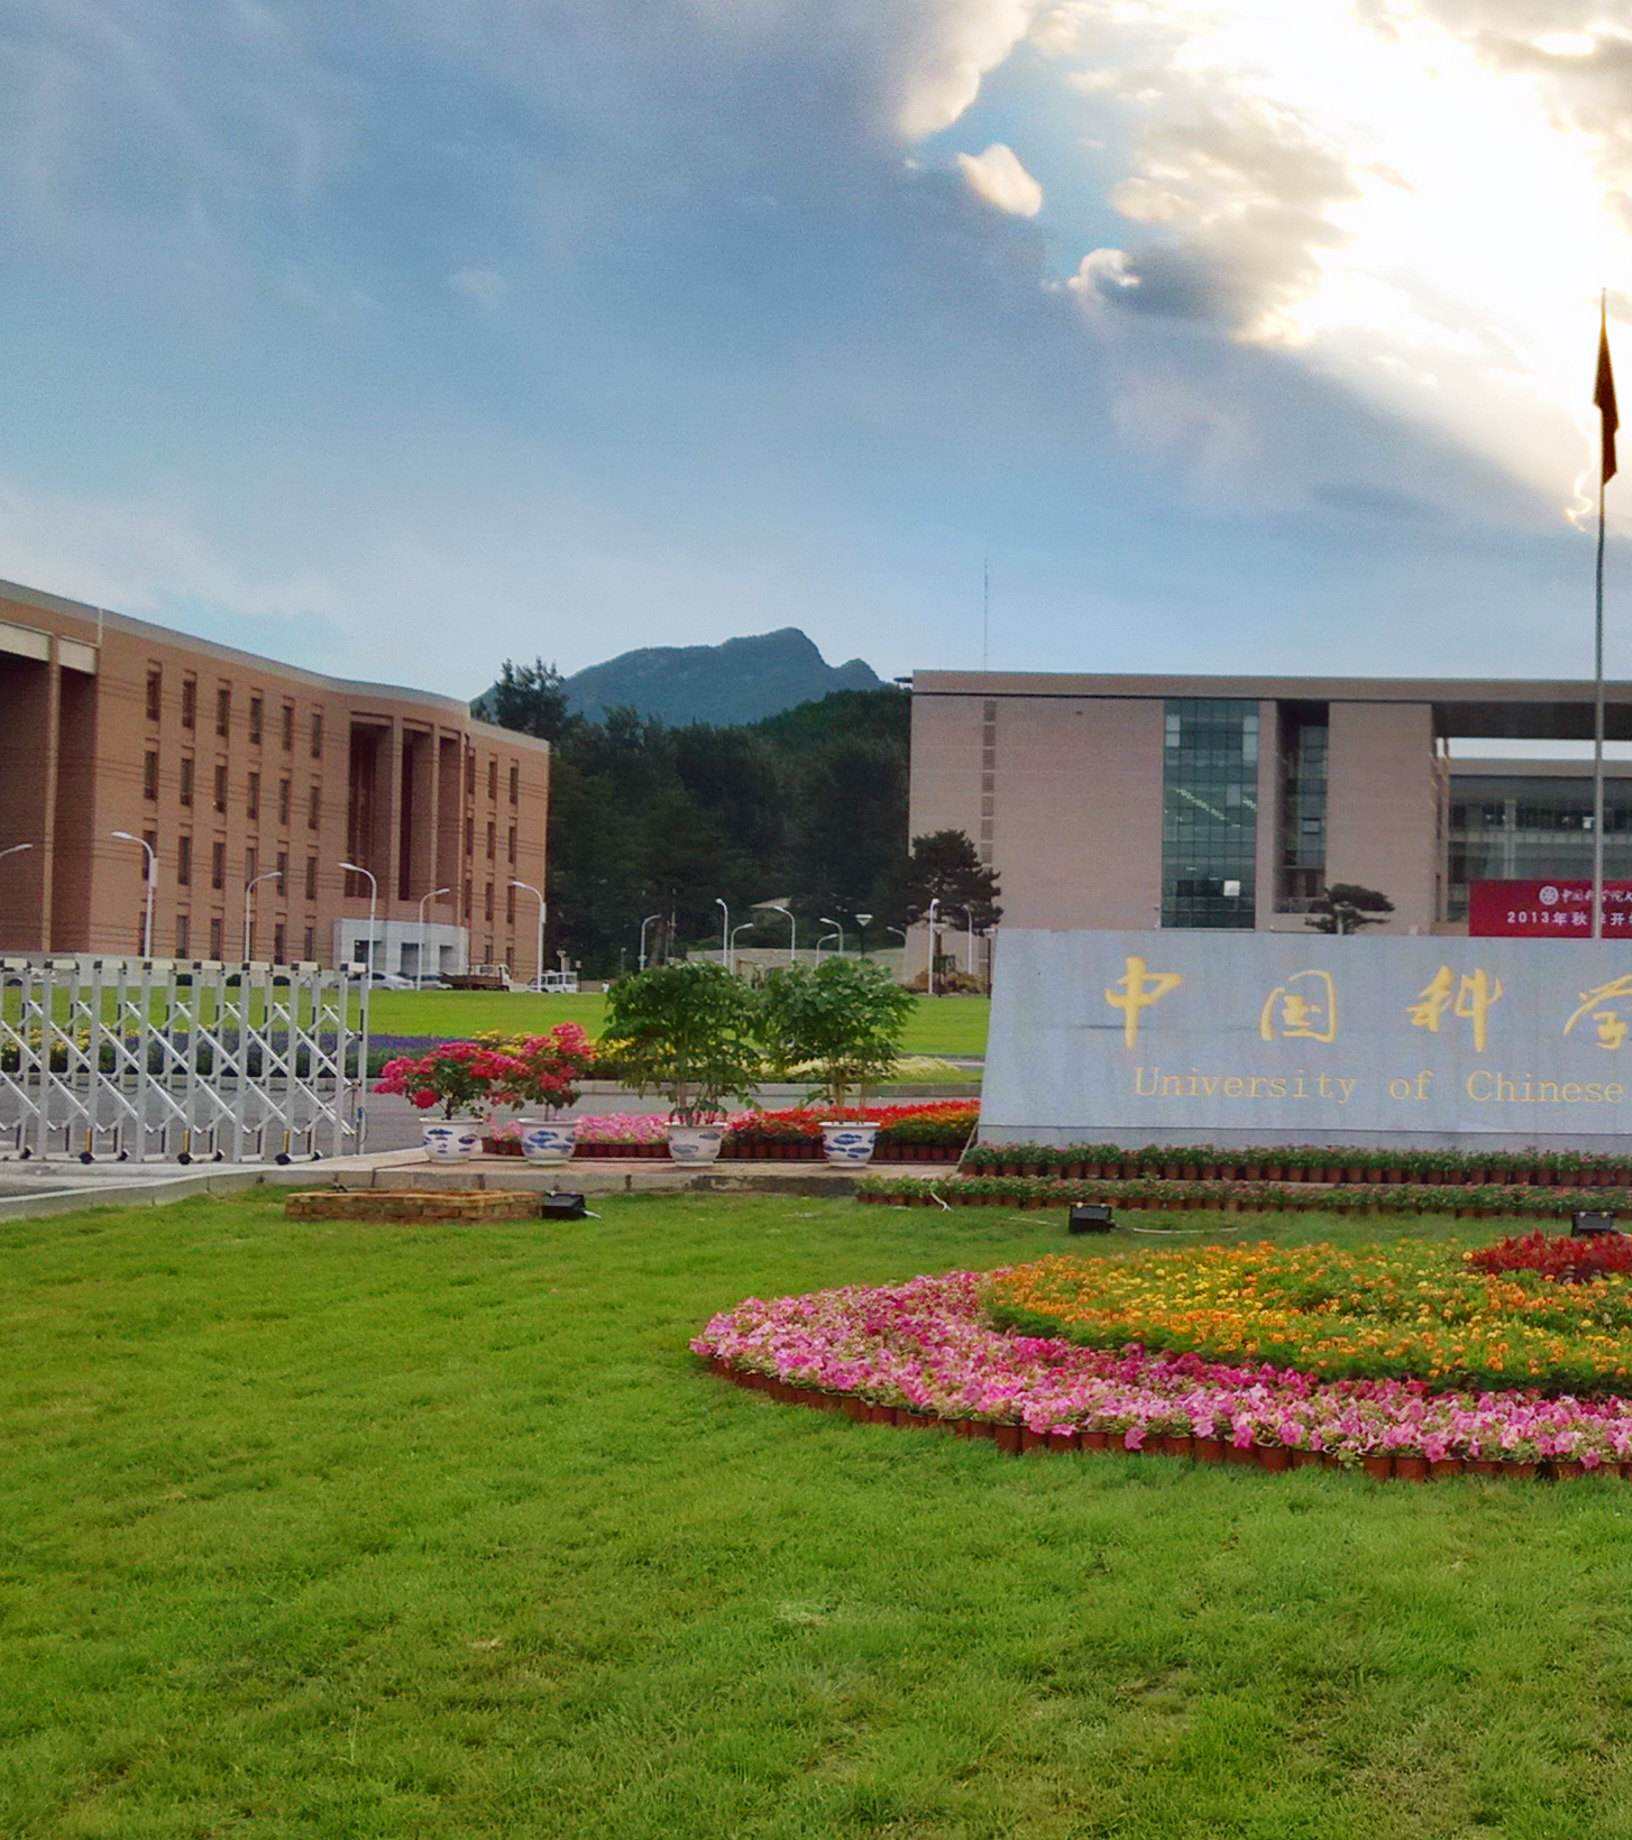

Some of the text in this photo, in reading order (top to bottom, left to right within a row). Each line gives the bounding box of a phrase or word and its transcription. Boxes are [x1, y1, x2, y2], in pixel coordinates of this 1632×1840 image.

[1134, 1066, 1356, 1106] University
[1388, 1069, 1434, 1101] of
[1465, 1070, 1624, 1104] Chinese
